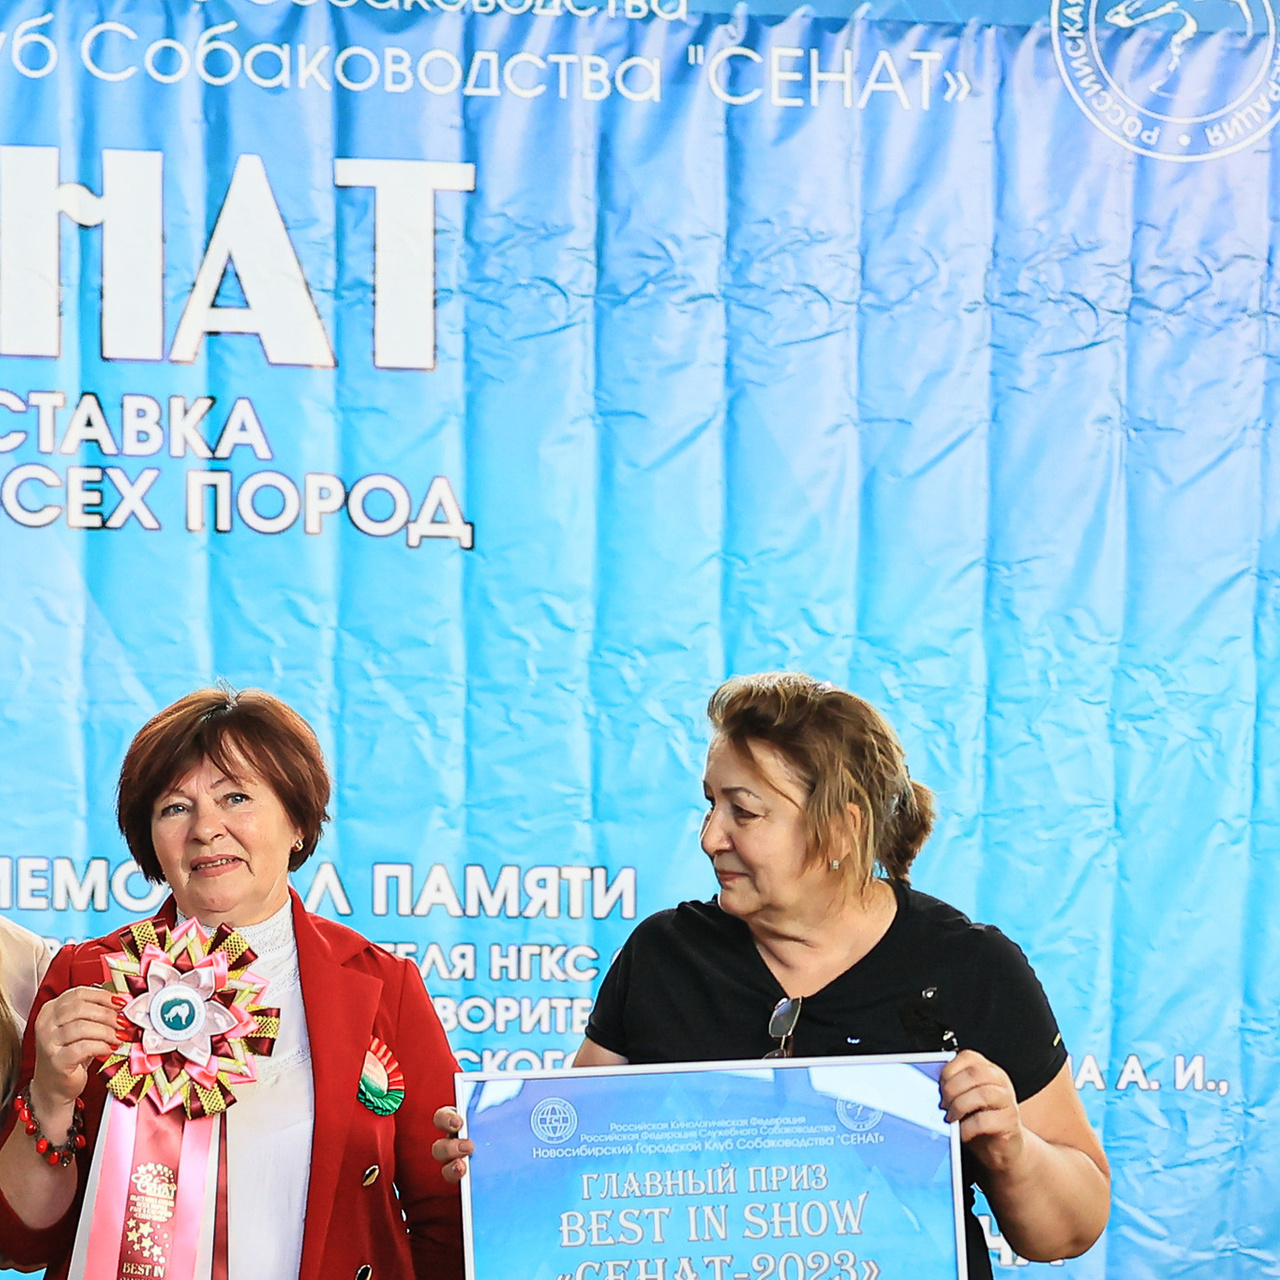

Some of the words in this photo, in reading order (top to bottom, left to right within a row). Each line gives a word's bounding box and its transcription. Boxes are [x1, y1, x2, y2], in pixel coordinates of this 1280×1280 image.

[81, 20, 662, 102] Собаководства
[1062, 0, 1160, 146] РОССИЙСКА
[186, 470, 475, 550] ПОРОД
[372, 862, 637, 920] ПАМЯТИ
[489, 943, 601, 983] НГКС
[1115, 1053, 1161, 1091] А.
[532, 1144, 633, 1159] Новосибирский
[635, 1140, 702, 1155] Городской
[704, 1137, 734, 1152] Клуб
[736, 1135, 834, 1151] Собаководства
[580, 1162, 737, 1201] ГЛАВНЫЙ
[748, 1164, 829, 1192] ПРИЗ
[559, 1206, 672, 1248] BEST
[686, 1204, 730, 1243] IN
[742, 1190, 869, 1240] SHOW
[122, 1261, 152, 1277] BEST
[153, 1264, 166, 1279] IN
